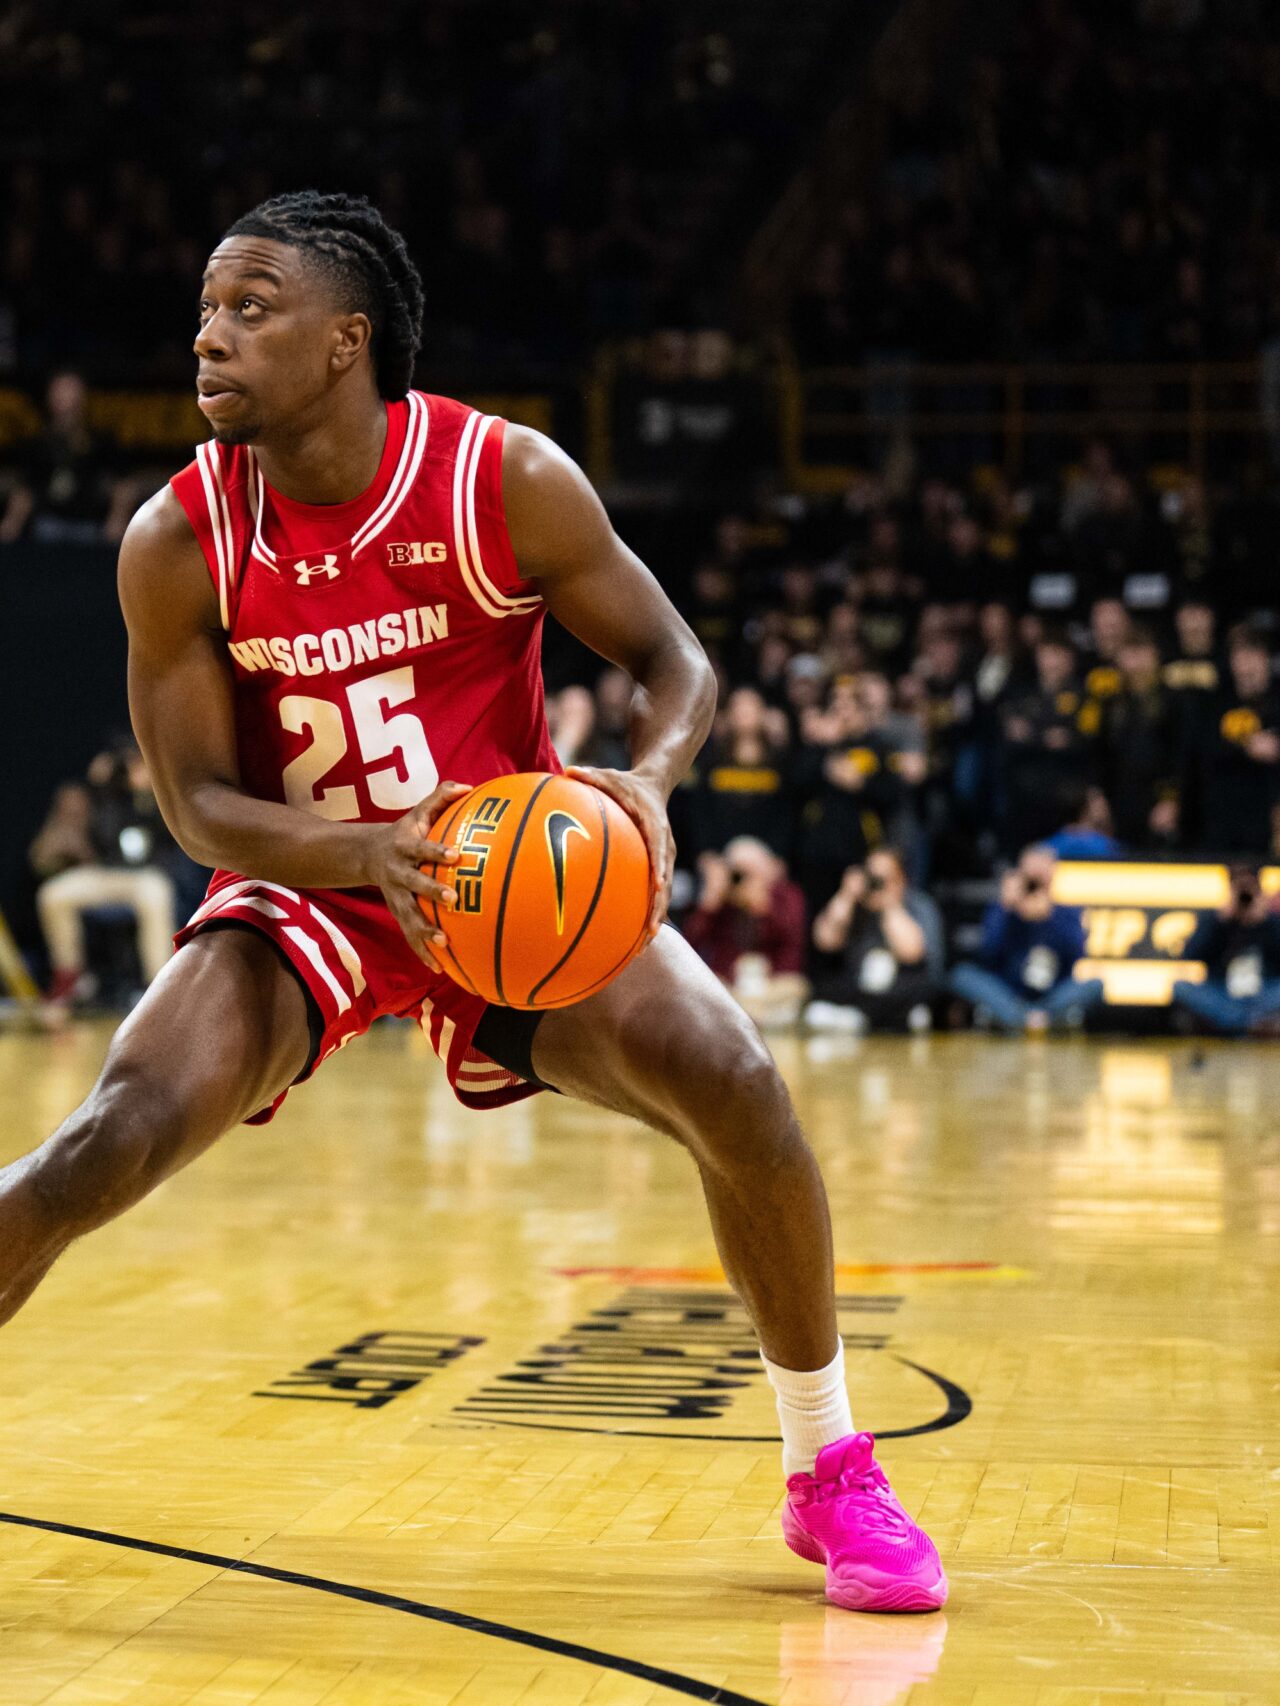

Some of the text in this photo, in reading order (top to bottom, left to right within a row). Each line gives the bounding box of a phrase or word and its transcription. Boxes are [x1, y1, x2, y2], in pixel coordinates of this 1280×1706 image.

[227, 603, 449, 677] WISCONSIN
[278, 665, 439, 821] 25
[455, 796, 511, 914] ELITE
[251, 1330, 487, 1409] COURT
